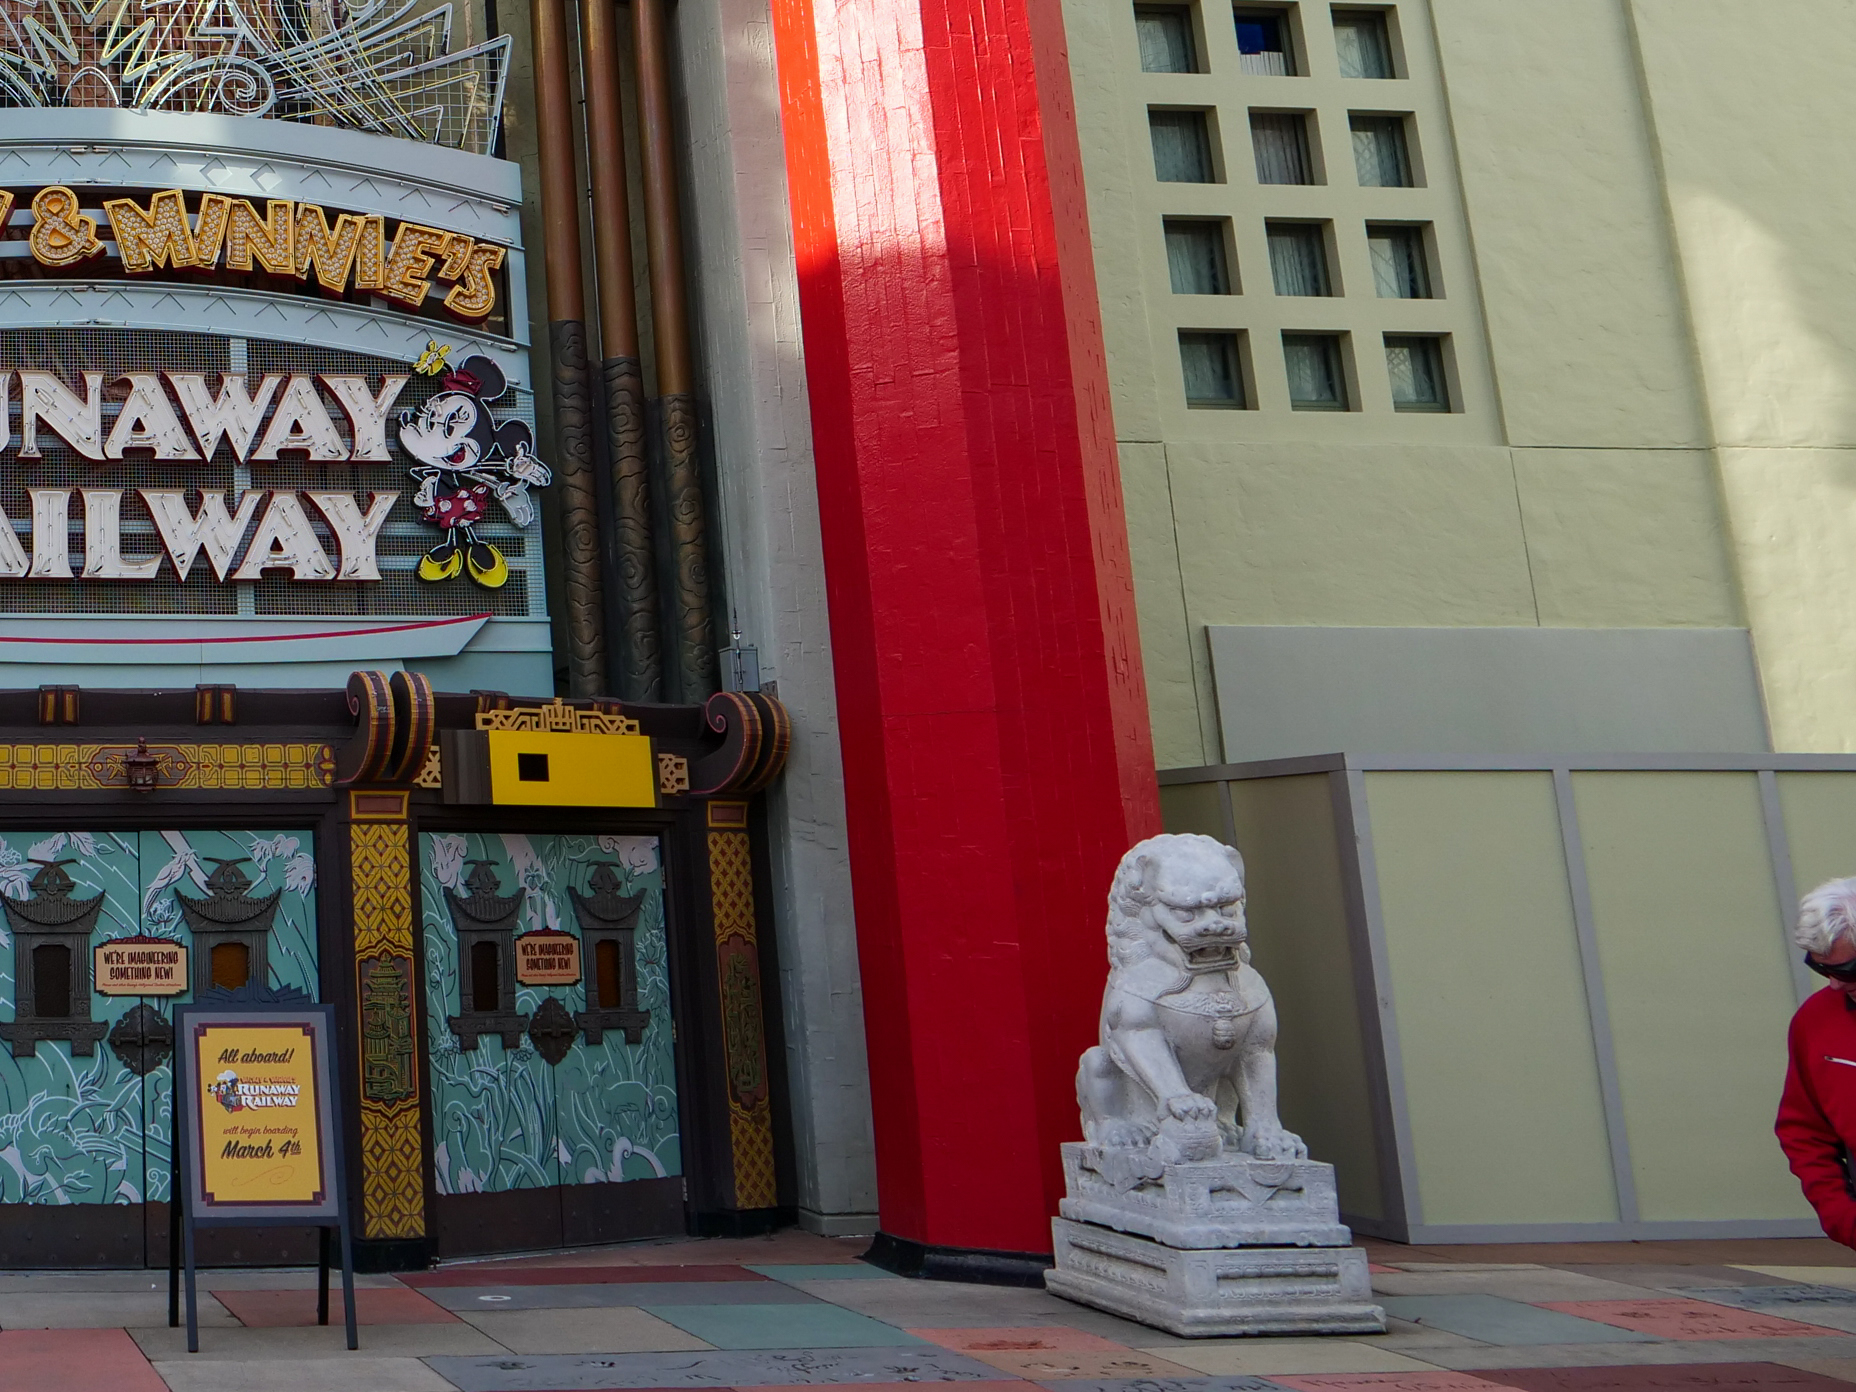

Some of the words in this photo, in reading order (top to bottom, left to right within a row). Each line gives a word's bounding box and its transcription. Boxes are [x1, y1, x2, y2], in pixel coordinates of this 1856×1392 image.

[29, 185, 107, 268] &
[103, 188, 506, 324] MINNIE'S
[104, 949, 125, 965] WE'RE
[128, 950, 179, 965] IMAGINEERING
[110, 966, 152, 980] SOMETHING
[155, 966, 174, 980] NEW!
[217, 1048, 240, 1064] All
[240, 1047, 295, 1064] aboard!
[235, 1083, 300, 1096] RUNAWAY
[241, 1095, 298, 1111] RAILWAY
[223, 1125, 239, 1135] will
[239, 1125, 261, 1139] begin
[262, 1125, 298, 1139] boarding
[220, 1138, 274, 1159] March
